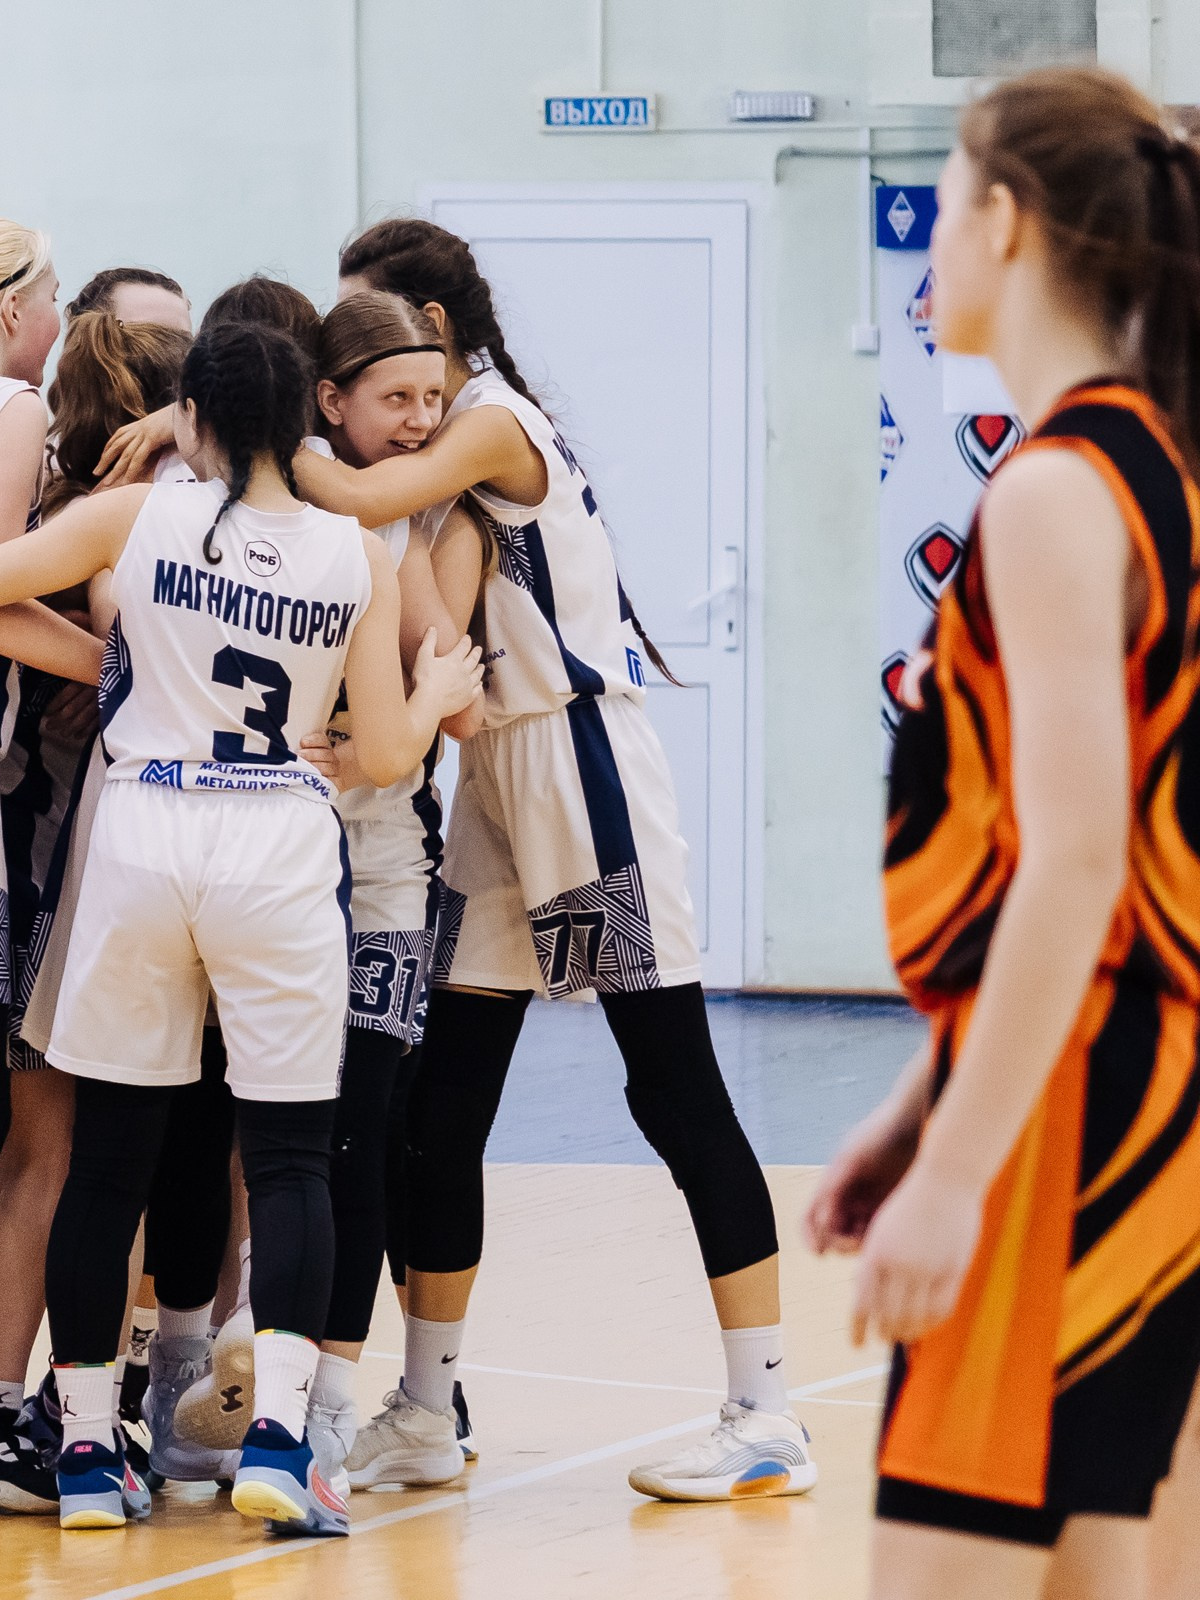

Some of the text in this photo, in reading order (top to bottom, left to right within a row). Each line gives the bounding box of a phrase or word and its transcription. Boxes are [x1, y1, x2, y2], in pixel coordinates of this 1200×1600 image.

[550, 100, 646, 124] ВЫХОД
[249, 549, 277, 566] РФБ
[153, 558, 357, 649] МАГНИТОГОРСК
[211, 643, 298, 766] 3
[348, 945, 420, 1028] 31
[529, 907, 608, 989] 77
